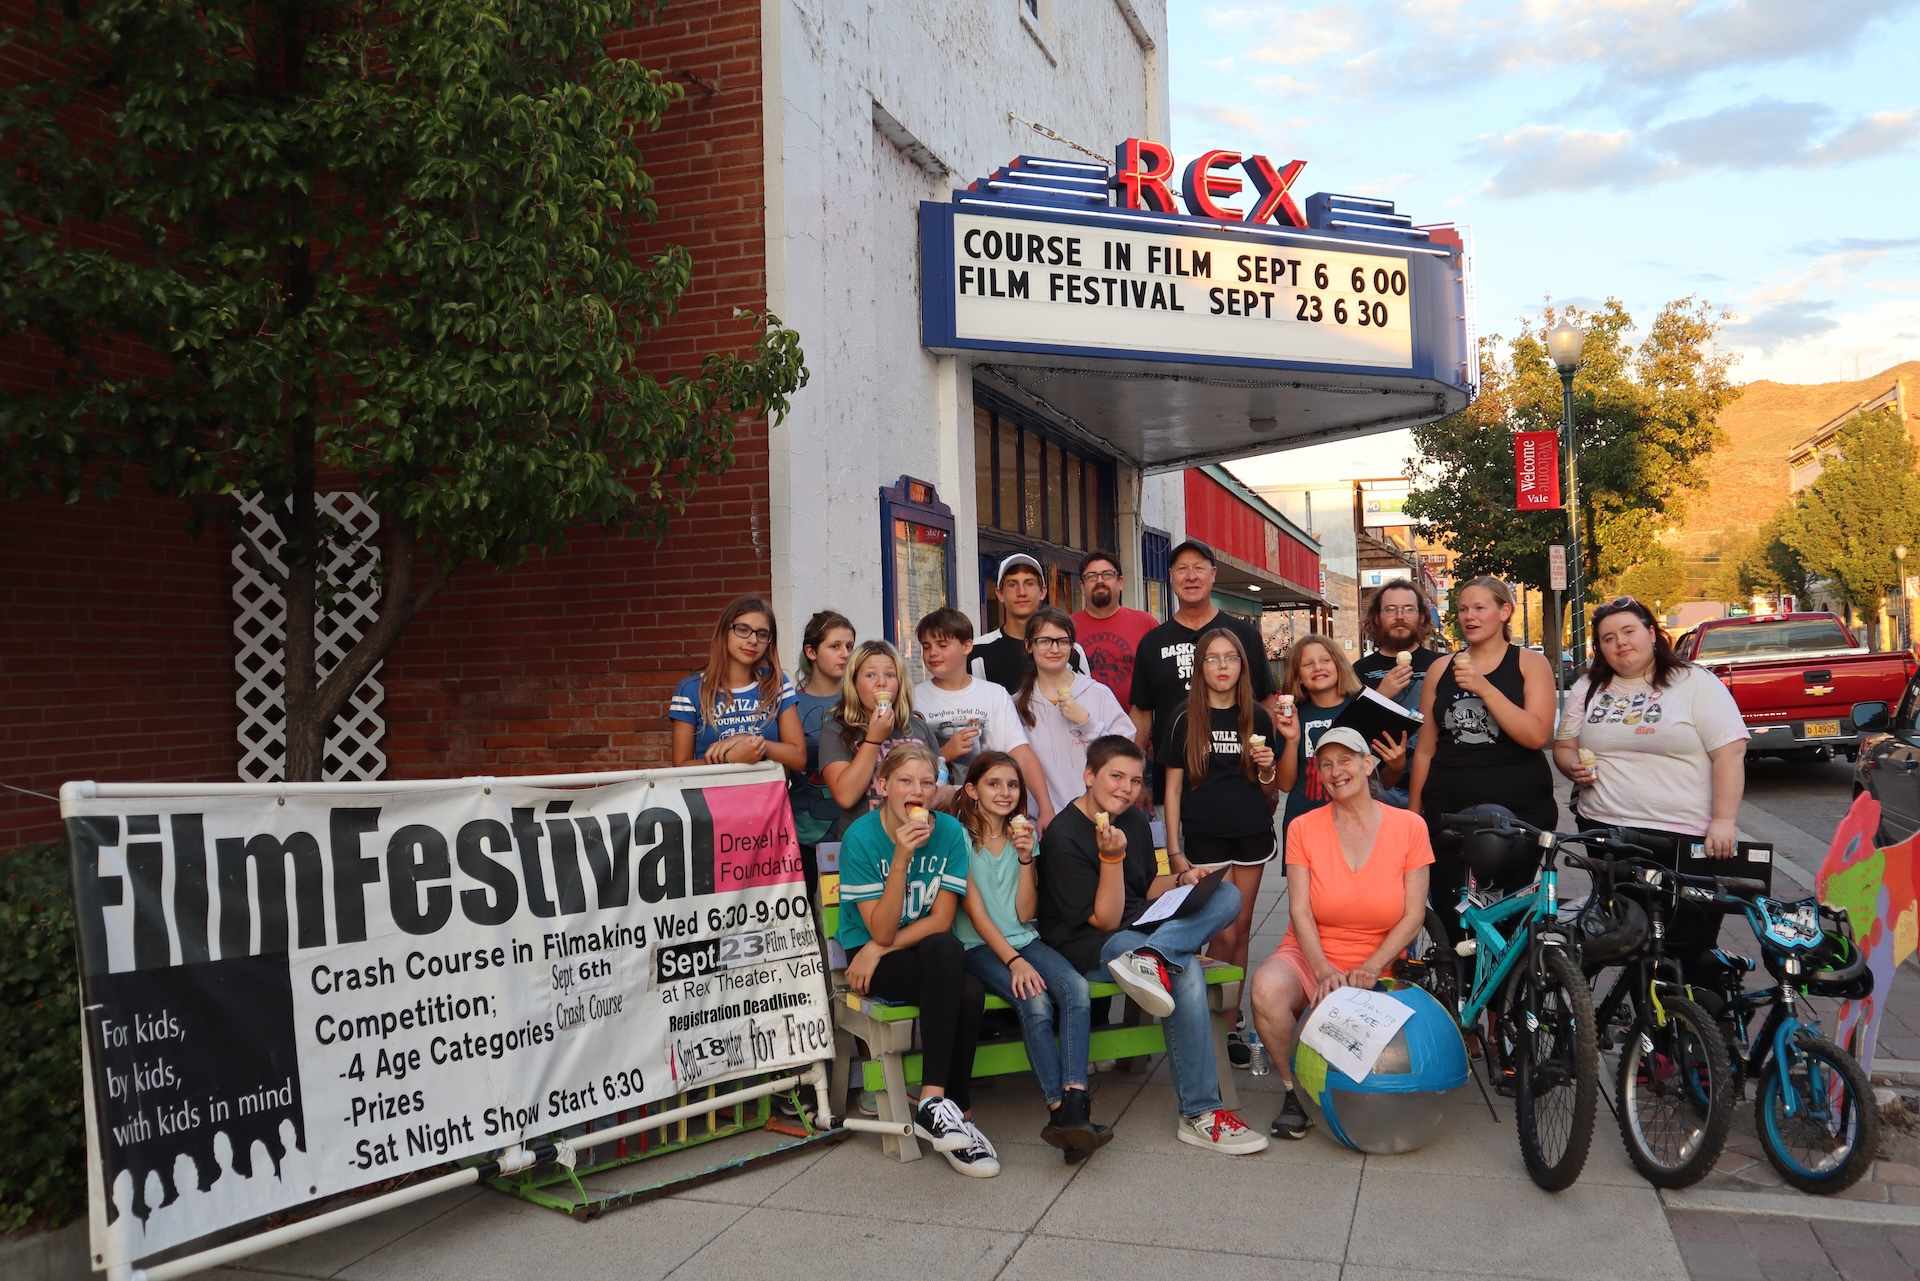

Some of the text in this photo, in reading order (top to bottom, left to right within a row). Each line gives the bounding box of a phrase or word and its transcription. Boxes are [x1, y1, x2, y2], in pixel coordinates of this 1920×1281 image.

[1115, 137, 1310, 229] REX
[963, 229, 1083, 267] COURSE
[1104, 241, 1131, 271] IN
[1148, 245, 1212, 279] FILM
[1237, 256, 1302, 287] SEPT
[1313, 263, 1329, 290] 6
[960, 265, 1030, 300] FILM
[1049, 273, 1185, 312] FESTIVAL
[1210, 287, 1275, 319] SEPT
[1296, 294, 1323, 322] 23
[1520, 440, 1537, 492] Welcome
[1528, 494, 1549, 503] Vale
[1212, 731, 1237, 741] VALE
[720, 829, 773, 854] Drexel
[68, 788, 716, 974] FilmFestival
[721, 855, 803, 883] Foundatio
[311, 957, 395, 995] Crash
[406, 947, 504, 980] Course
[512, 938, 534, 964] in
[543, 923, 647, 960] Filmaking
[654, 910, 698, 940] Wed
[721, 934, 764, 962] 23
[765, 931, 790, 953] Film
[552, 959, 612, 995] Sept 6th
[662, 958, 824, 1004] at Rex Theater, Vale
[101, 1009, 186, 1049] For kids,
[315, 994, 496, 1045] Competition;
[556, 993, 623, 1029] Crash Course
[669, 992, 812, 1033] Registration Deadline:
[376, 1048, 421, 1079] Age
[430, 1020, 554, 1065] Categories
[694, 1039, 725, 1060] 18
[750, 1018, 777, 1069] for
[782, 1013, 828, 1056] Free
[106, 1057, 182, 1104] by kids,
[112, 1076, 293, 1147] with kids in mind
[344, 1089, 425, 1127] -Prizes
[348, 1068, 644, 1170] -Sat Night Show Start 6:30
